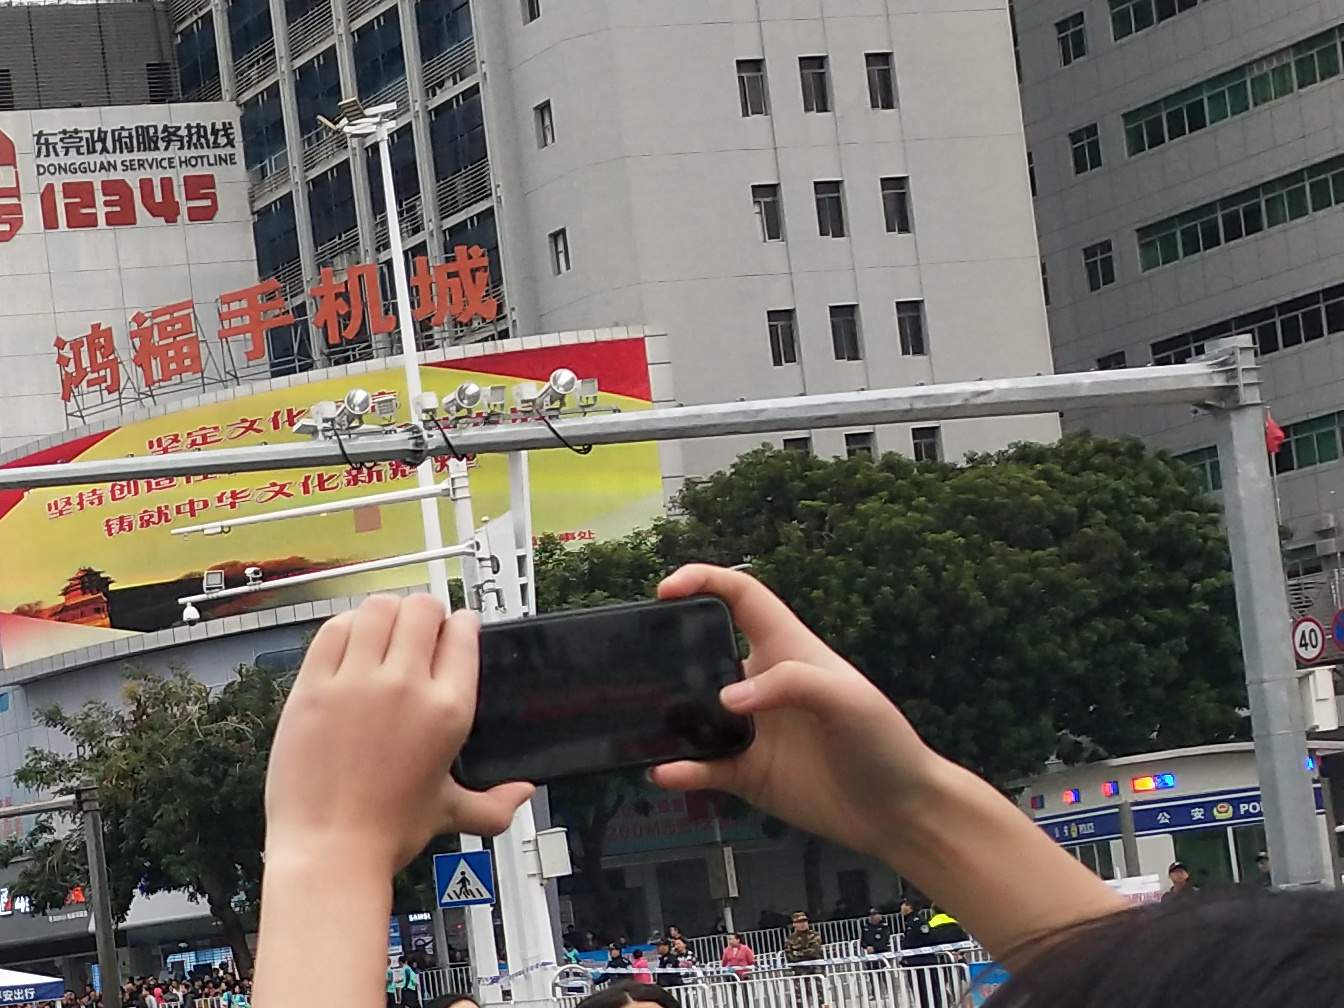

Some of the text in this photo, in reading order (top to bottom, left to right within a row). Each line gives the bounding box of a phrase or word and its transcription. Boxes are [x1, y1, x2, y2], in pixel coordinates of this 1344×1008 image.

[33, 121, 236, 158] 东莞政府服务热线
[36, 152, 237, 176] DONGGUAN SERVICE HOTLINE
[40, 174, 218, 230] 12345
[53, 244, 498, 402] 鸿福手机城
[1298, 627, 1318, 651] 40
[1156, 801, 1263, 824] 公安 PO
